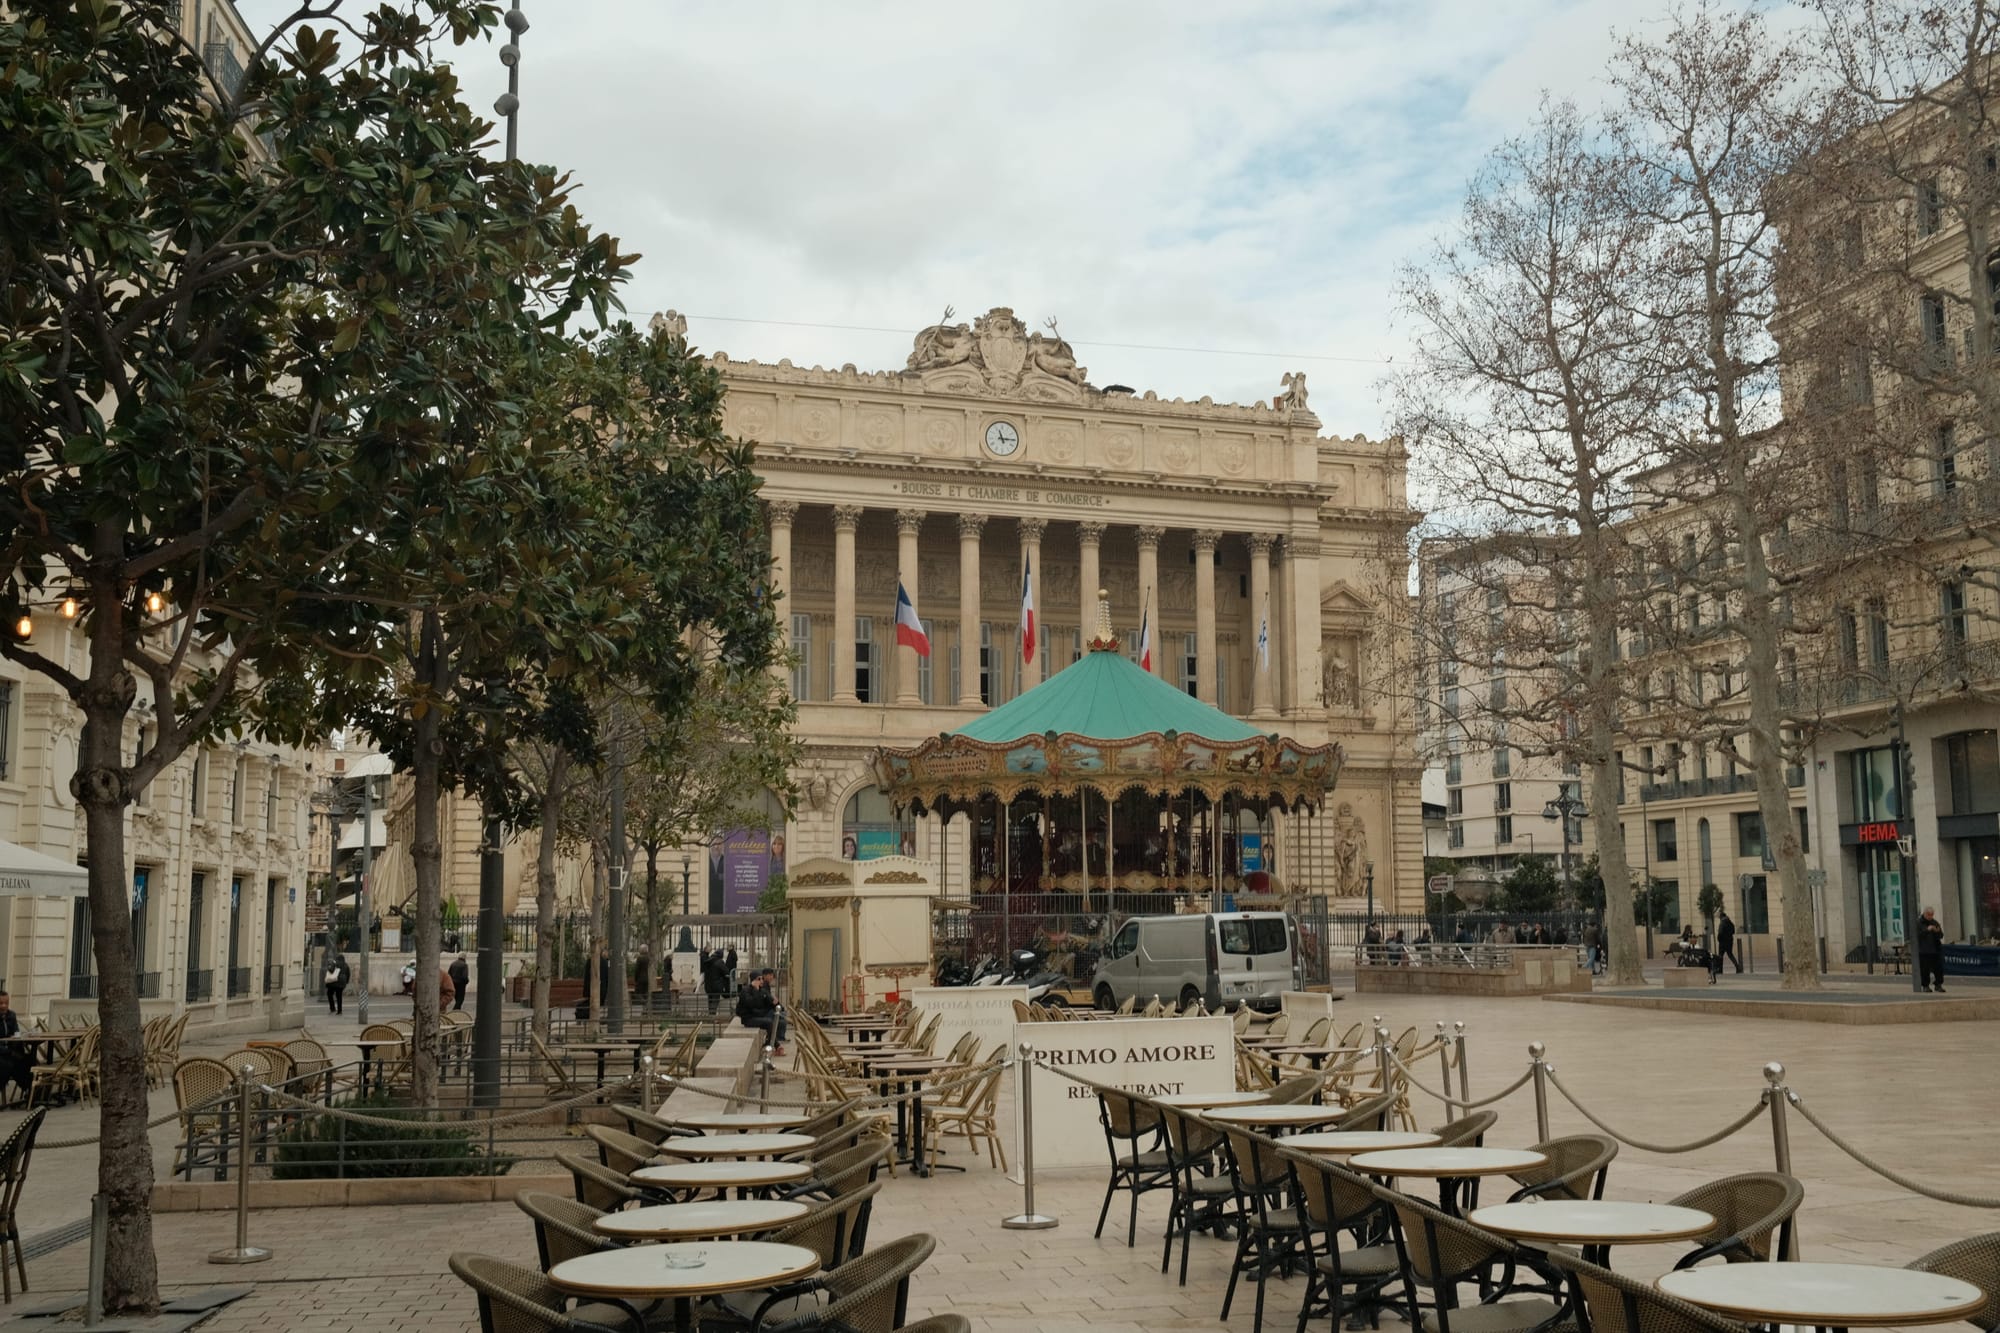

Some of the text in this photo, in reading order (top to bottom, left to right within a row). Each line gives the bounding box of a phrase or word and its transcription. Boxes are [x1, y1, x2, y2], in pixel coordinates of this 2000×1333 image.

[901, 482, 1103, 507] BOURSE ET CHAMBRE DE COMMERCE
[1858, 823, 1899, 842] HEMA
[1034, 1044, 1216, 1066] PRIMO AMORE
[1068, 1082, 1184, 1099] REURANT
